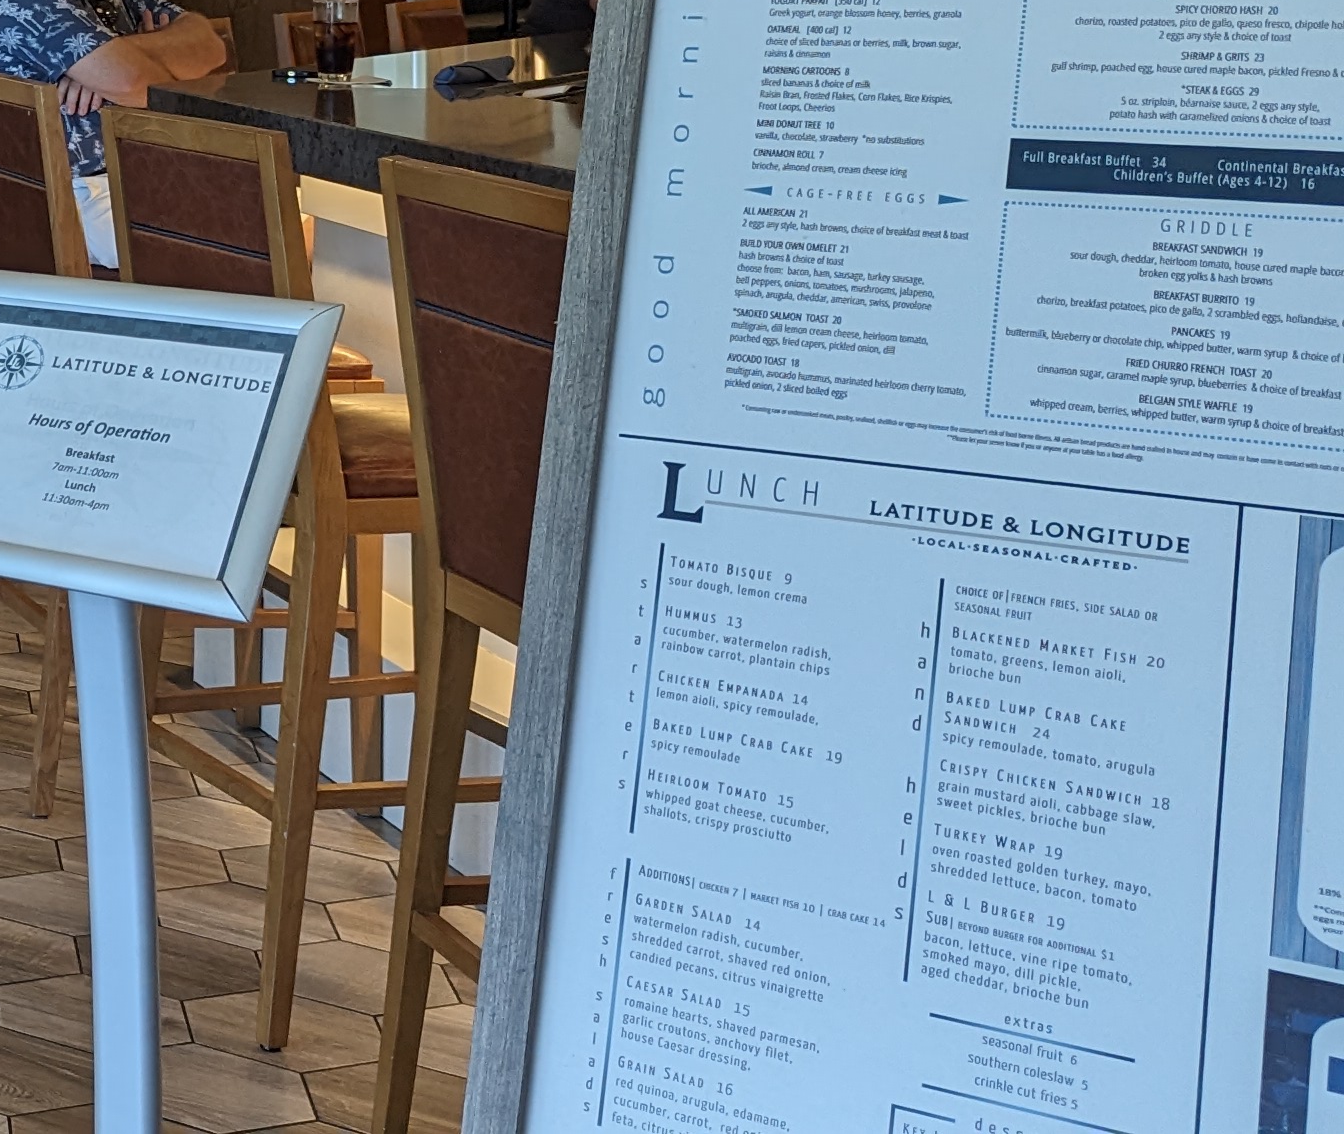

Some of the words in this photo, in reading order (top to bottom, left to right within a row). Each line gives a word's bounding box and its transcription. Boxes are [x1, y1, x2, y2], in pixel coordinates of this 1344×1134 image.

[1175, 5, 1198, 15] SPICY
[1200, 5, 1237, 15] CHORIZO
[1240, 6, 1263, 15] HASH
[1268, 6, 1278, 15] 20
[1181, 52, 1215, 61] SHRIMP
[1217, 53, 1222, 61] &
[1225, 53, 1249, 62] GRITS
[1254, 54, 1264, 62] 23
[1213, 87, 1218, 96] &
[1220, 87, 1244, 97] EGGS
[1249, 87, 1259, 97] 29
[1023, 151, 1044, 163] Full
[1048, 152, 1101, 166] Breakfast
[1105, 154, 1141, 168] Buffet
[1153, 157, 1166, 168] 34
[1218, 160, 1288, 174] Continental
[1114, 169, 1172, 183] Children's
[1177, 172, 1213, 185] Buffet
[1217, 175, 1250, 189] (Ages
[1254, 176, 1288, 190] 4-12)
[1301, 178, 1315, 190] 16
[787, 187, 873, 202] CAGE-FREE
[885, 191, 925, 204] EGGS
[1161, 219, 1253, 237] GRIDDLE
[1153, 242, 1198, 254] BREAKFAST
[1200, 245, 1247, 256] SANDWICH
[1253, 247, 1263, 257] 19
[1154, 290, 1200, 303] BREAKFAST
[1202, 293, 1239, 305] BURRITO
[1244, 296, 1255, 306] 19
[770, 311, 802, 322] SALMON
[806, 313, 829, 324] TOAST
[833, 315, 841, 325] 20
[643, 255, 675, 408] good
[1171, 327, 1215, 339] PANCAKES
[1221, 330, 1230, 340] 19
[727, 353, 762, 364] AVOCADO
[764, 355, 786, 366] TOAST
[791, 357, 800, 367] 18
[1126, 358, 1150, 369] FRIED
[1152, 359, 1188, 372] CHURRO
[1191, 362, 1225, 375] FRENCH
[1230, 365, 1256, 377] TOAST
[1262, 369, 1272, 379] 20
[51, 356, 138, 378] LATITUDE
[143, 366, 154, 380] &
[161, 368, 271, 394] LONGITUDE
[1139, 394, 1175, 407] BELGIAN
[1177, 397, 1201, 408] STYLE
[1203, 399, 1237, 412] WAFFLE
[1243, 403, 1253, 414] 19
[28, 413, 72, 431] Hours
[74, 419, 92, 435] of
[94, 422, 171, 445] Operation
[66, 447, 115, 464] Breakfast
[52, 462, 119, 480] 7am-11:00am
[64, 479, 96, 494] Lunch
[657, 460, 819, 523] LUNCH
[42, 492, 110, 512] 11:30am-4pm
[869, 500, 993, 531] LATITUDE
[1002, 517, 1020, 533] &
[1030, 519, 1190, 554] LONGITUDE
[670, 555, 718, 574] TOMATO
[727, 564, 773, 582] BISQUE
[784, 573, 792, 585] 9
[665, 605, 716, 624] HUMMUS
[726, 615, 743, 628] 13
[952, 626, 1030, 649] BLACKENED
[1040, 639, 1094, 659] MARKET
[1104, 648, 1137, 665] FISH
[1146, 656, 1165, 668] 20
[658, 669, 710, 690] CHICKEN
[718, 679, 784, 702] EMPANADA
[793, 693, 808, 706] 14
[912, 622, 930, 731] hand
[653, 718, 693, 736] BAKED
[700, 727, 733, 743] LUMP
[741, 734, 773, 750] CRAB
[781, 741, 813, 758] CAKE
[826, 750, 843, 764] 19
[648, 769, 710, 792] HEIRLOOM
[718, 781, 766, 802] TOMATO
[778, 794, 794, 809] 15
[940, 759, 988, 779] CRISPY
[997, 769, 1056, 792] CHICKEN
[1065, 780, 1142, 806] SANDWICH
[1152, 797, 1170, 811] 18
[934, 823, 986, 845] TURKEY
[995, 834, 1035, 854] WRAP
[1045, 845, 1063, 860] 19
[636, 893, 684, 914] GARDEN
[692, 905, 732, 925] SALAD
[745, 918, 760, 931] 14
[928, 890, 934, 903] L
[945, 894, 954, 906] &
[964, 897, 970, 910] L
[981, 900, 1035, 924] BURGER
[1047, 915, 1065, 930] 19
[626, 976, 674, 998] CAESAR
[680, 988, 722, 1009] SALAD
[734, 1002, 750, 1017] 15
[1004, 1014, 1053, 1034] extras
[982, 1034, 1032, 1055] seasonal
[1036, 1045, 1062, 1063] fruit
[1070, 1055, 1078, 1065] 6
[618, 1055, 656, 1076] GRAIN
[664, 1067, 704, 1088] SALAD
[717, 1082, 733, 1096] 16
[968, 1052, 1020, 1074] southern
[1023, 1066, 1074, 1087] coleslaw
[1081, 1079, 1088, 1091] 5
[974, 1075, 1013, 1094] crinkle
[1017, 1086, 1036, 1100] cut
[1040, 1090, 1067, 1107] fries
[1071, 1099, 1078, 1110] 5
